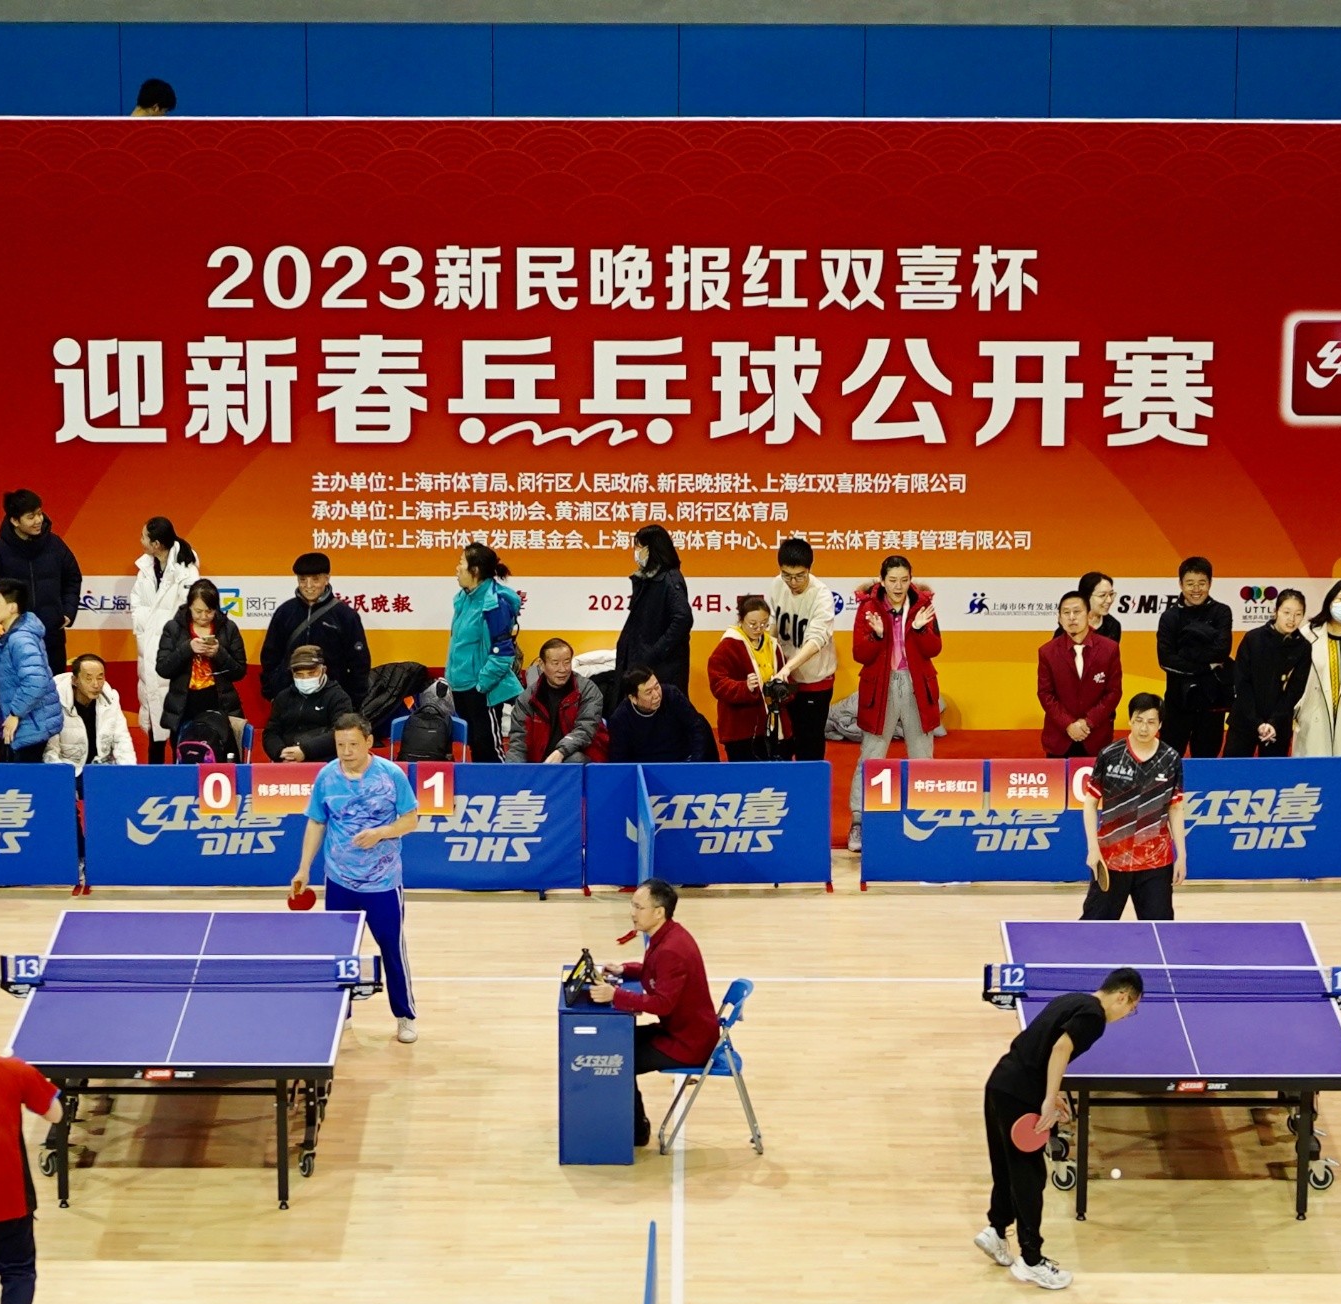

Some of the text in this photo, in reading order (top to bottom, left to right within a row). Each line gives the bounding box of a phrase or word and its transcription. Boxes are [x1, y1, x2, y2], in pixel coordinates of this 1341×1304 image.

[206, 244, 1039, 312] 2023新民晚报红双喜杯
[54, 335, 1215, 447] 迎新春乒乓球公开赛
[246, 597, 277, 611] 闵行
[203, 772, 233, 809] 0
[257, 783, 315, 797] 伟多利俱乐
[422, 771, 444, 808] 1
[869, 768, 893, 805] 1
[1009, 772, 1047, 786] SHAO
[197, 831, 285, 856] DHS
[444, 836, 542, 862] DHS
[695, 829, 784, 855] DHS
[975, 827, 1060, 852] DHS
[1229, 825, 1317, 851] DHS
[16, 957, 39, 978] 13
[336, 959, 360, 980] 13
[1001, 967, 1025, 988] 12
